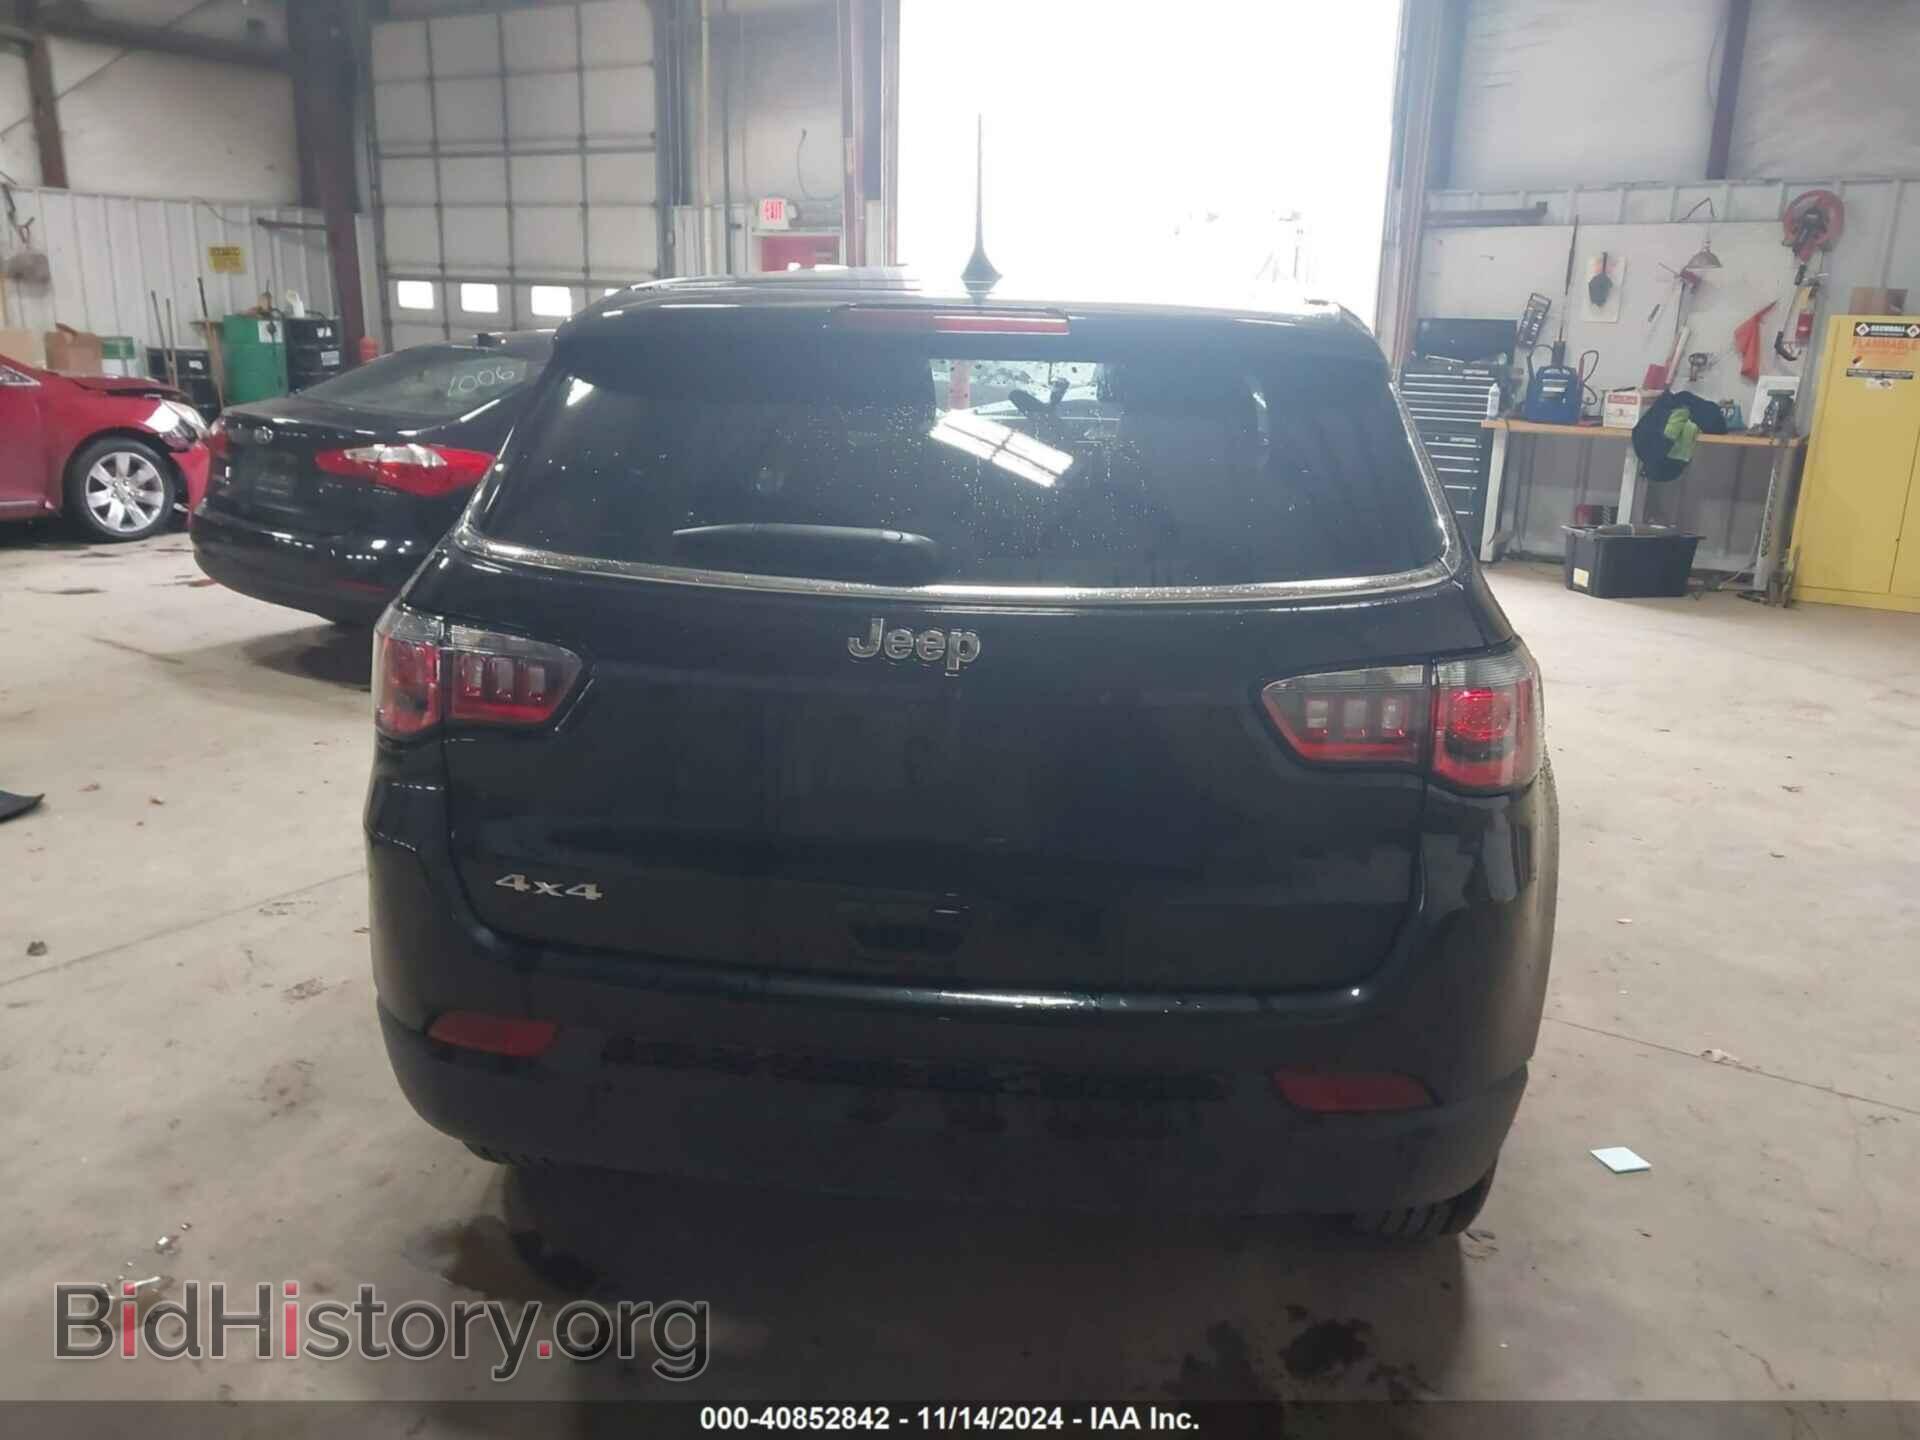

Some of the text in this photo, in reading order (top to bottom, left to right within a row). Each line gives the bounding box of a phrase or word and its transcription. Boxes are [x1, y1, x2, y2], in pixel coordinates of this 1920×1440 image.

[763, 200, 784, 221] EXIT
[847, 617, 981, 671] Jeep
[495, 873, 603, 900] 4x4
